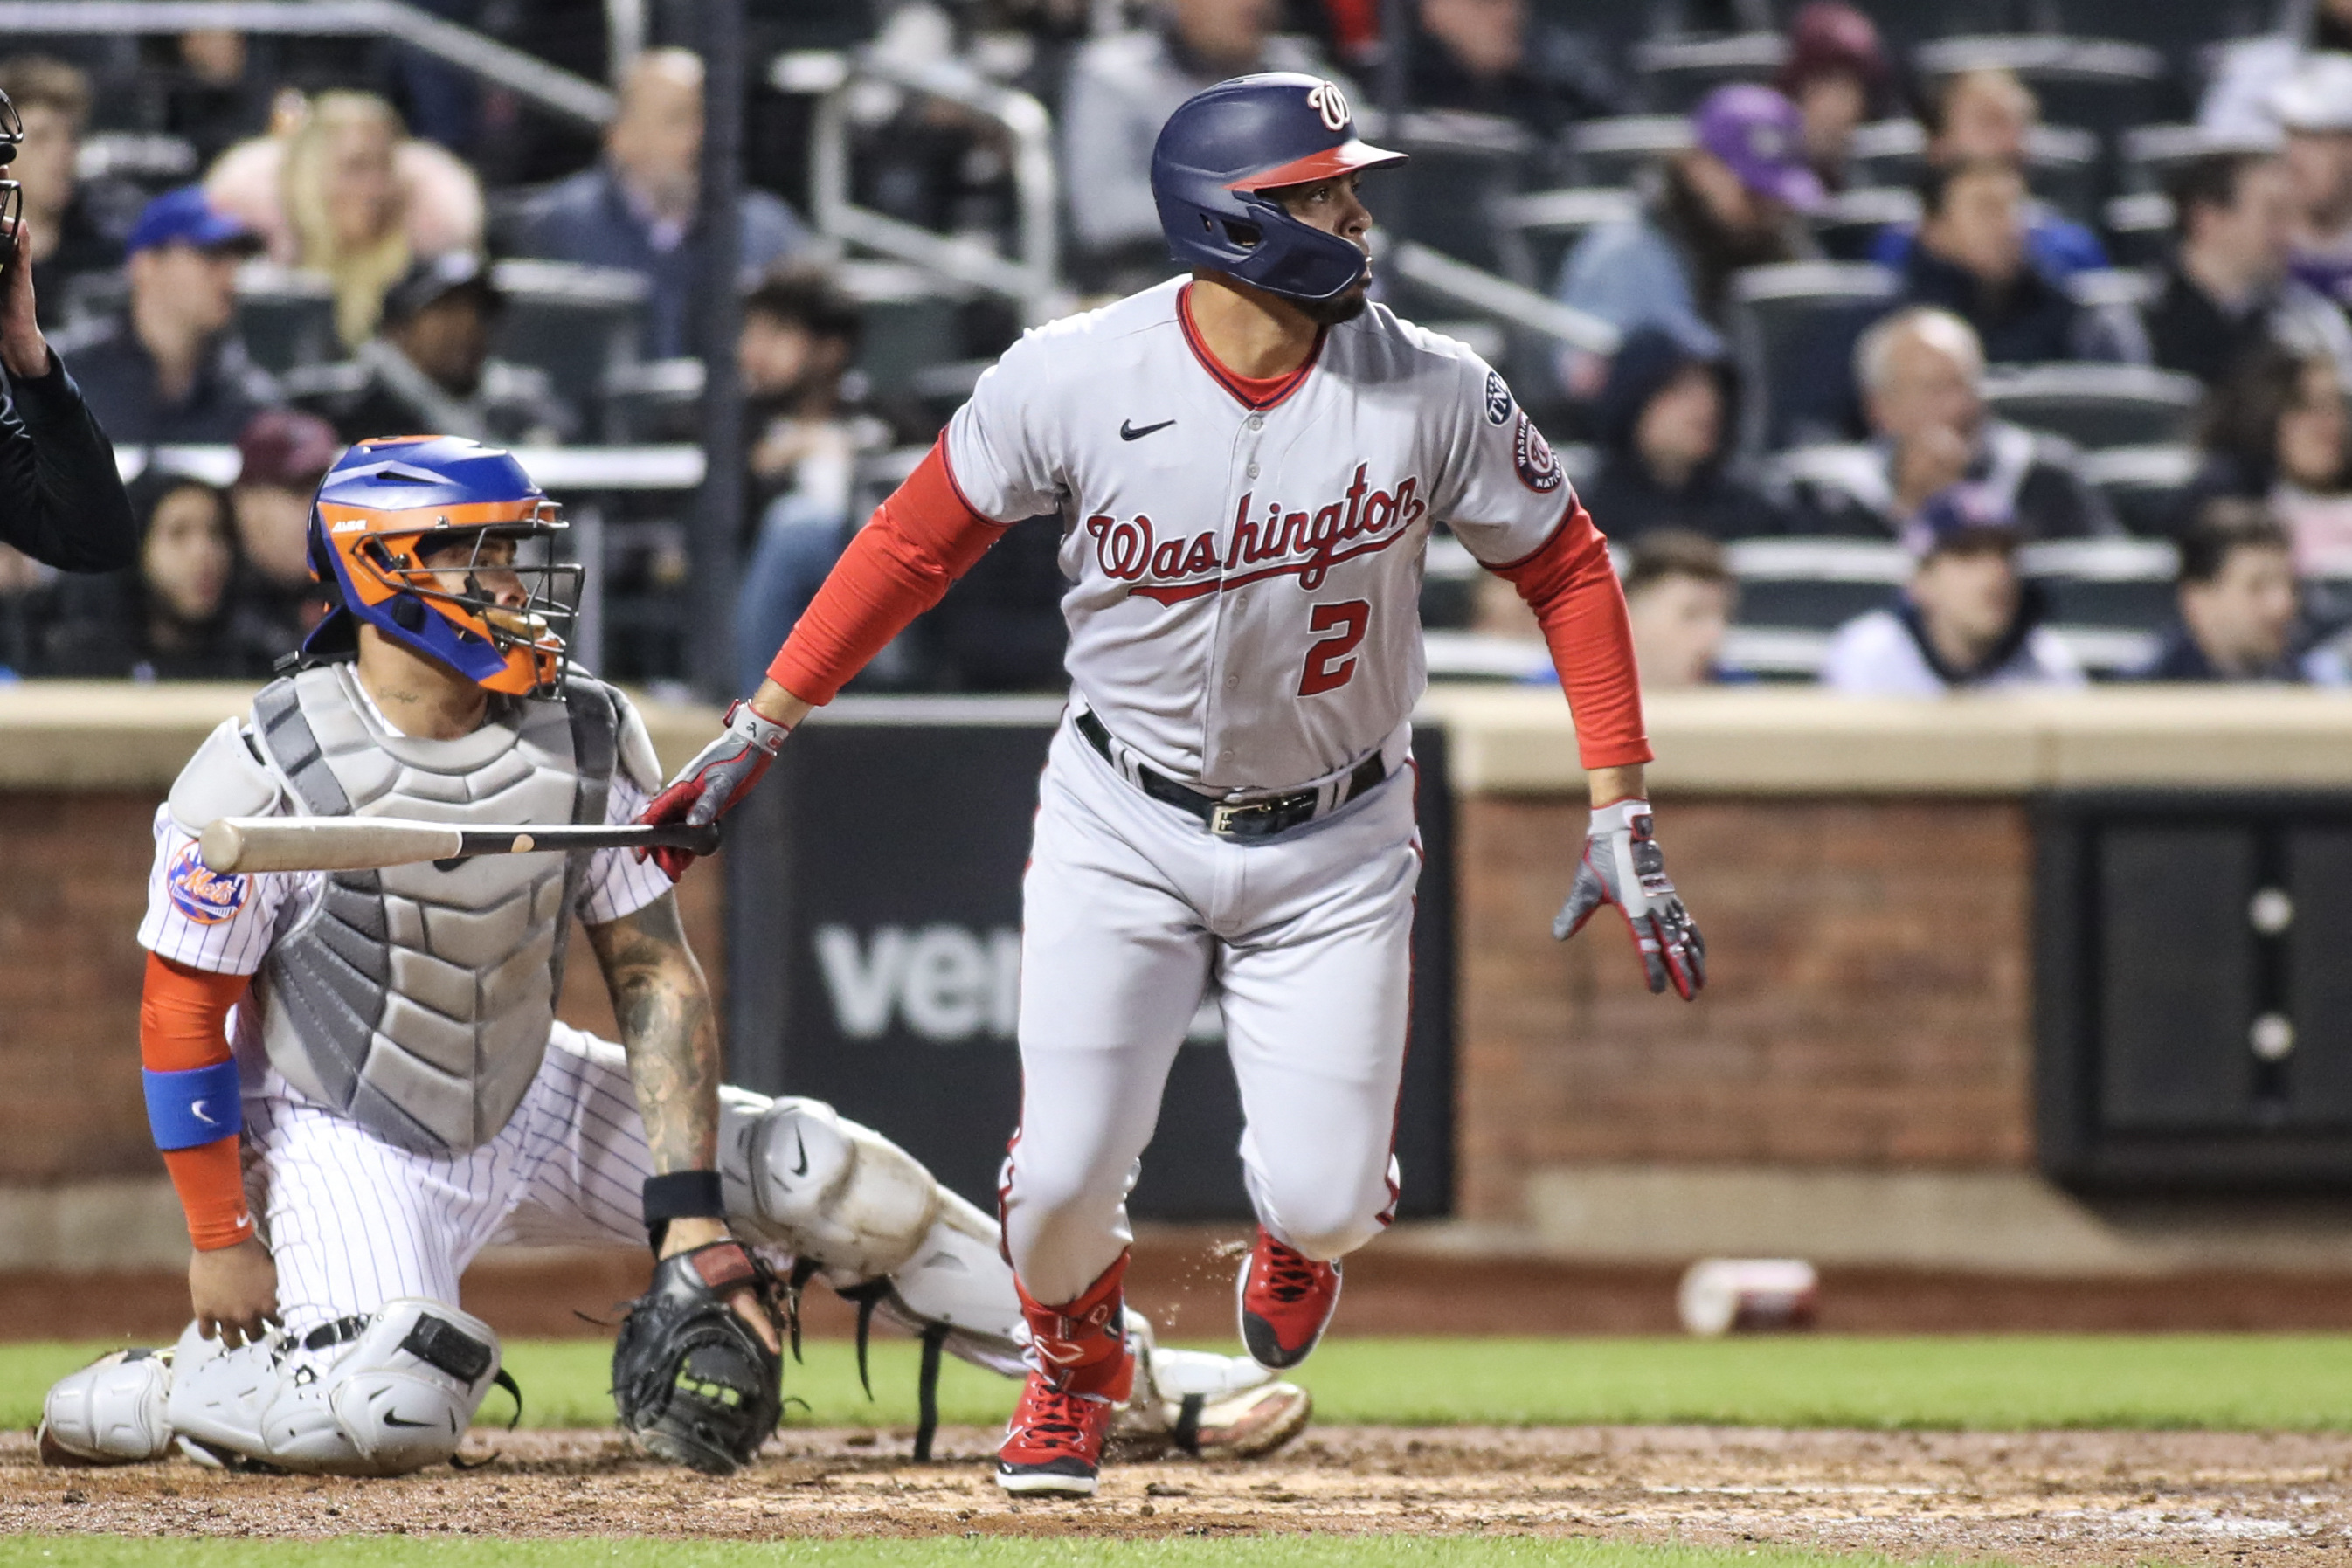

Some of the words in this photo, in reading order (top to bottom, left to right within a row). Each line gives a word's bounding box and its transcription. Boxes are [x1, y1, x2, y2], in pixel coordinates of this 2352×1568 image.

[1307, 81, 1351, 132] W
[1087, 459, 1427, 592] Washington
[1298, 599, 1370, 698] 2
[176, 866, 236, 905] Mets
[815, 923, 1021, 1040] ver
